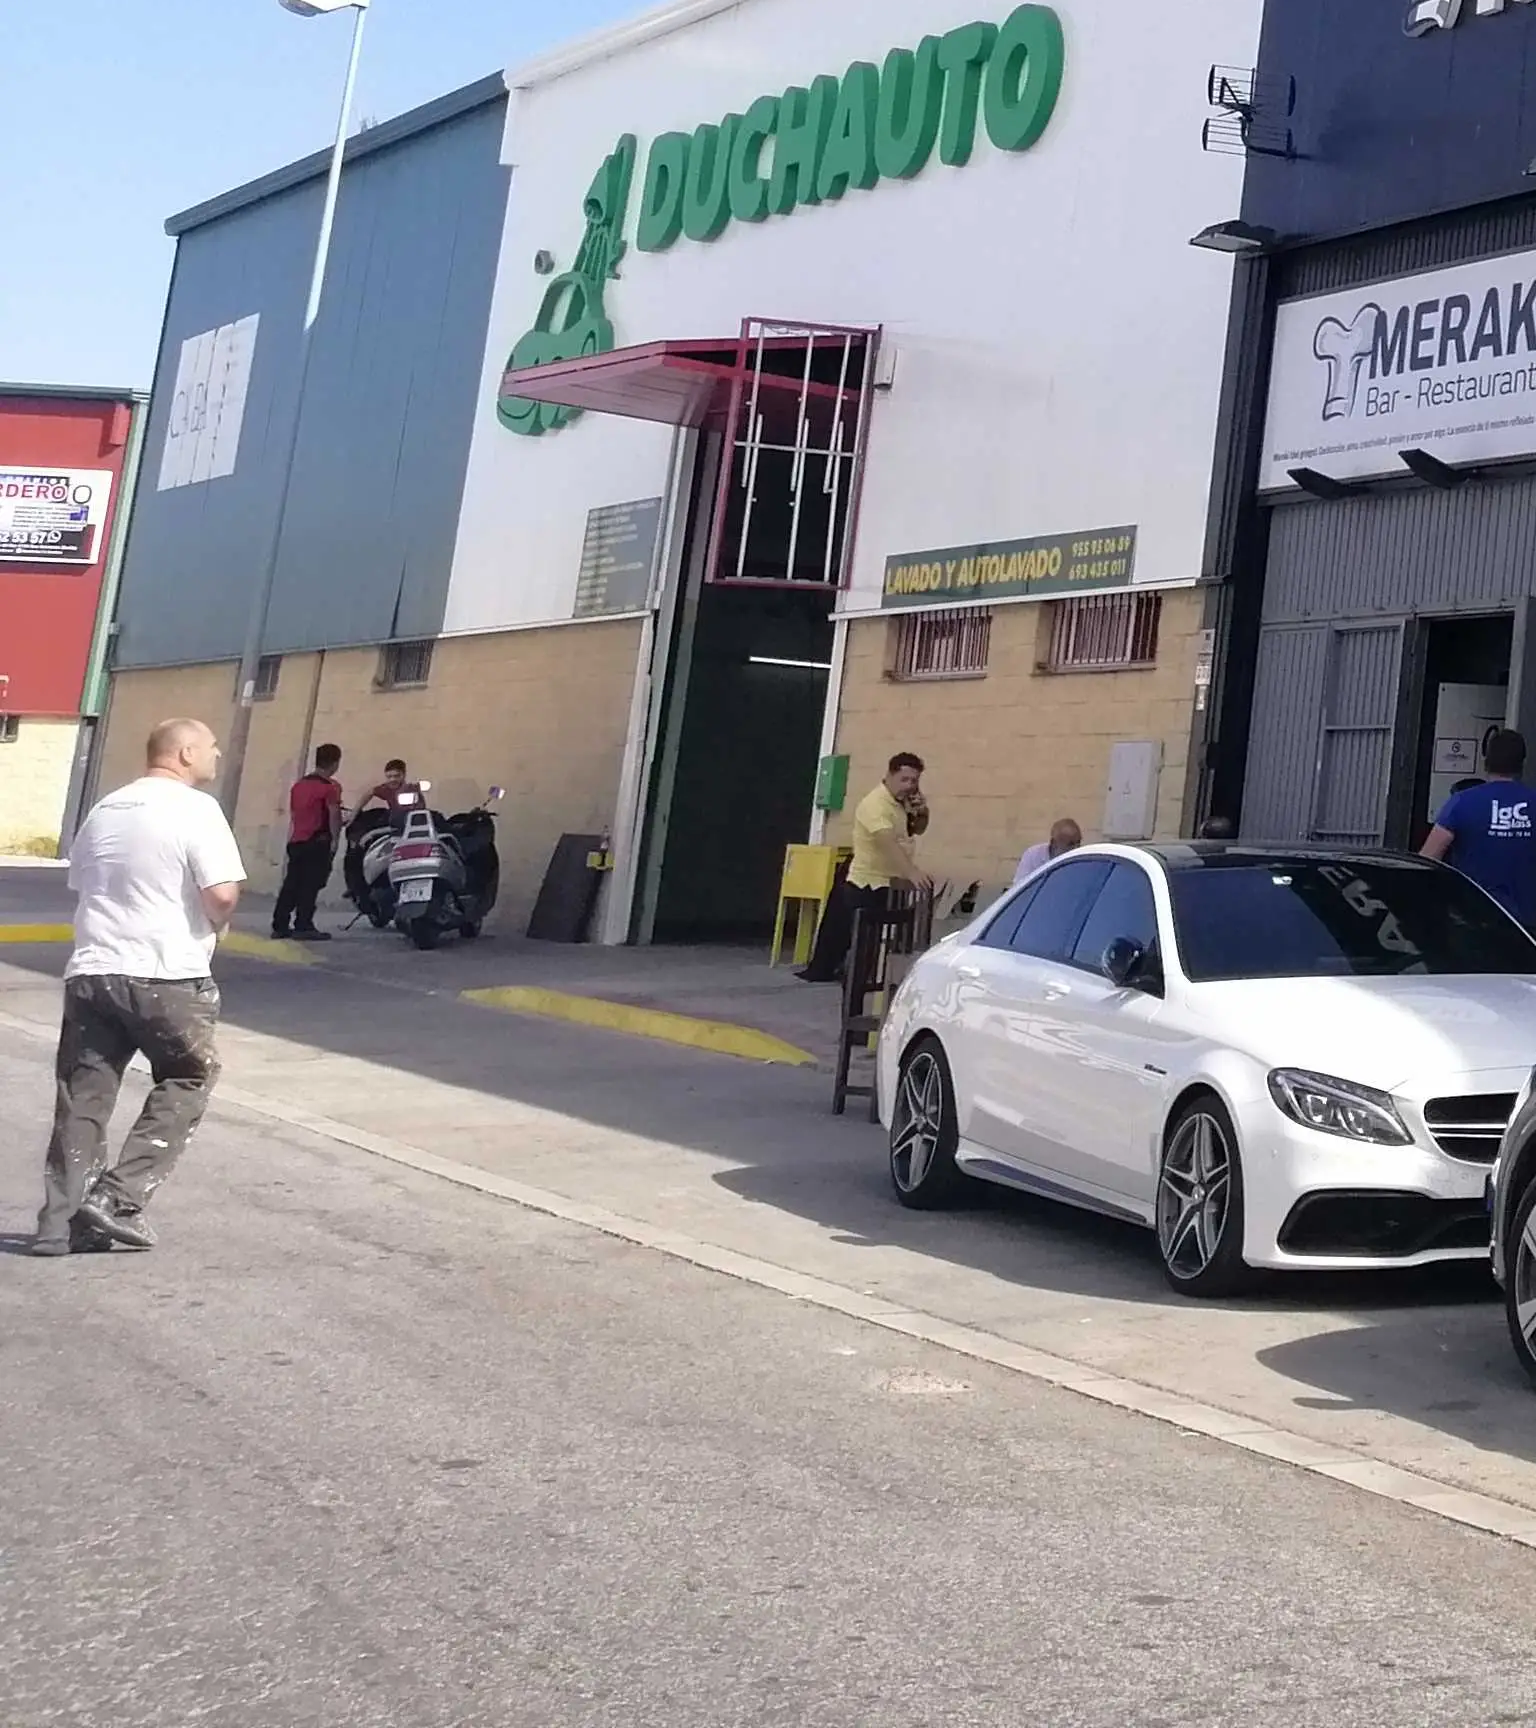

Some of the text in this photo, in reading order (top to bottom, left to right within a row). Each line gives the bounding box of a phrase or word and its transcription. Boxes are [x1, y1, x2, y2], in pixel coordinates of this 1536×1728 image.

[637, 3, 1065, 252] DUCHAUTO
[1366, 387, 1399, 417] Bar
[885, 547, 1062, 595] LAVADO Y AUTOLAVADO
